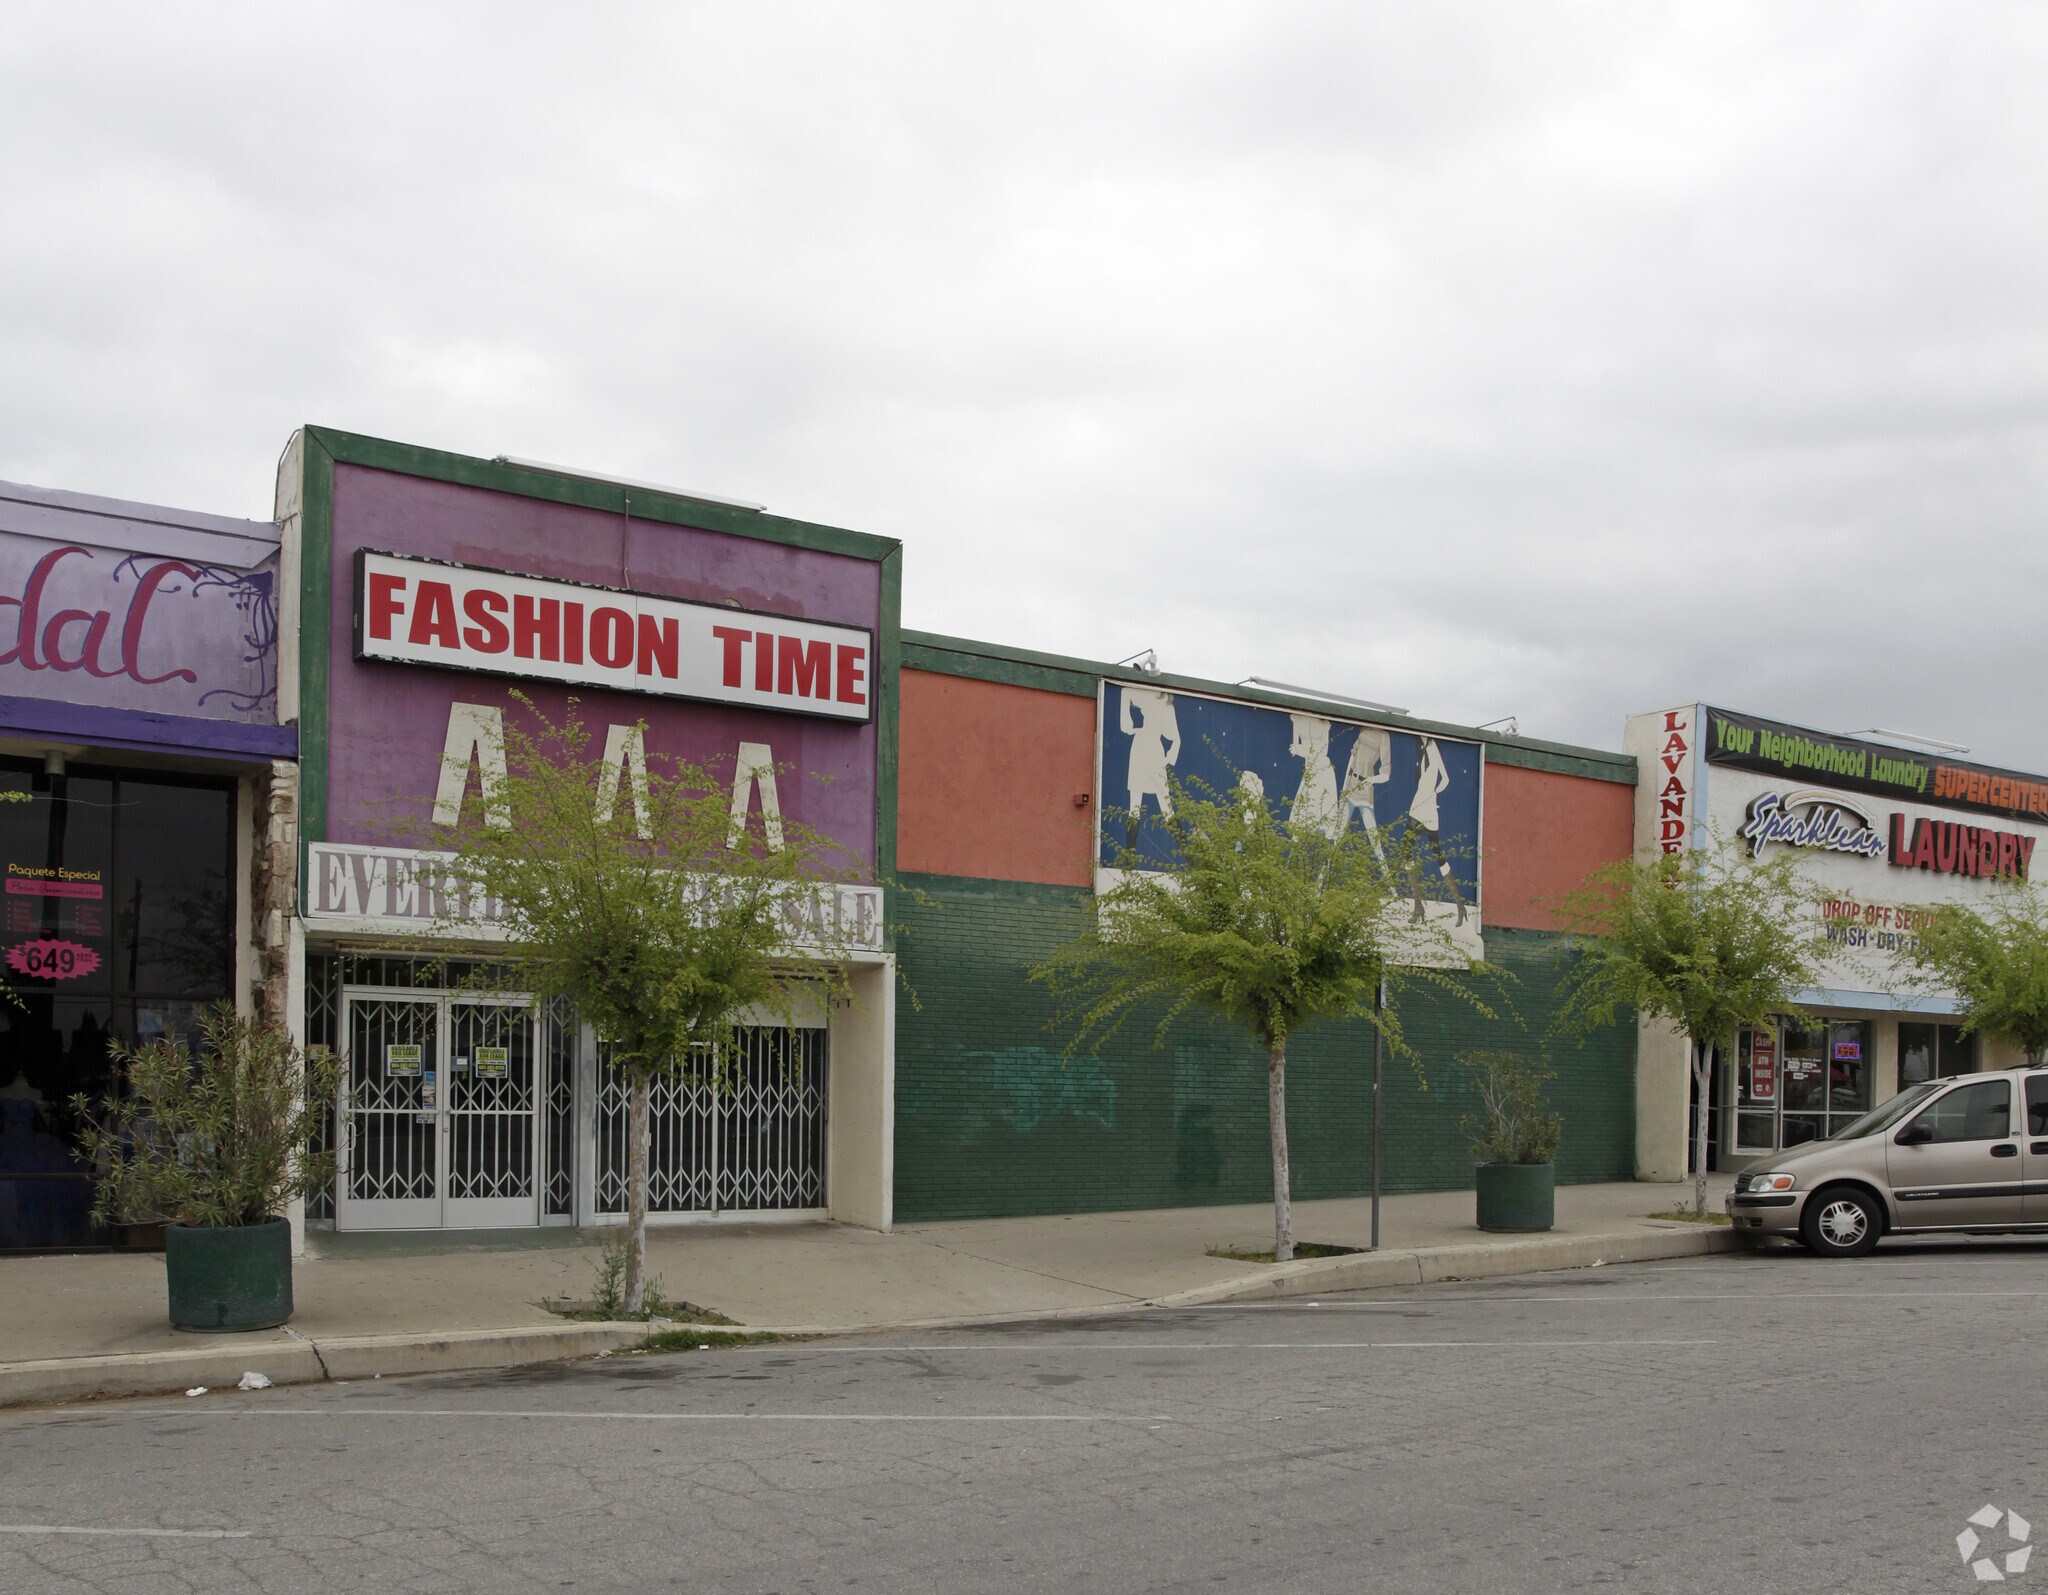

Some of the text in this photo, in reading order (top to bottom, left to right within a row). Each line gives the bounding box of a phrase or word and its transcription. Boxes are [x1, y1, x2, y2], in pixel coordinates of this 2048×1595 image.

[369, 572, 866, 705] FASHION TIME
[1715, 718, 2048, 815] Your Neighborhood Laundry SUPERCENTER
[1746, 793, 1888, 858] Sparklean
[1891, 813, 2037, 881] LAUNDRY
[8, 863, 101, 881] Paquete Especial
[1822, 898, 1860, 921] DROP
[1865, 904, 1893, 928] OFF
[1757, 1056, 1769, 1065] ATM
[1837, 1045, 1858, 1057] OPEN
[1754, 1069, 1772, 1079] INSIDE
